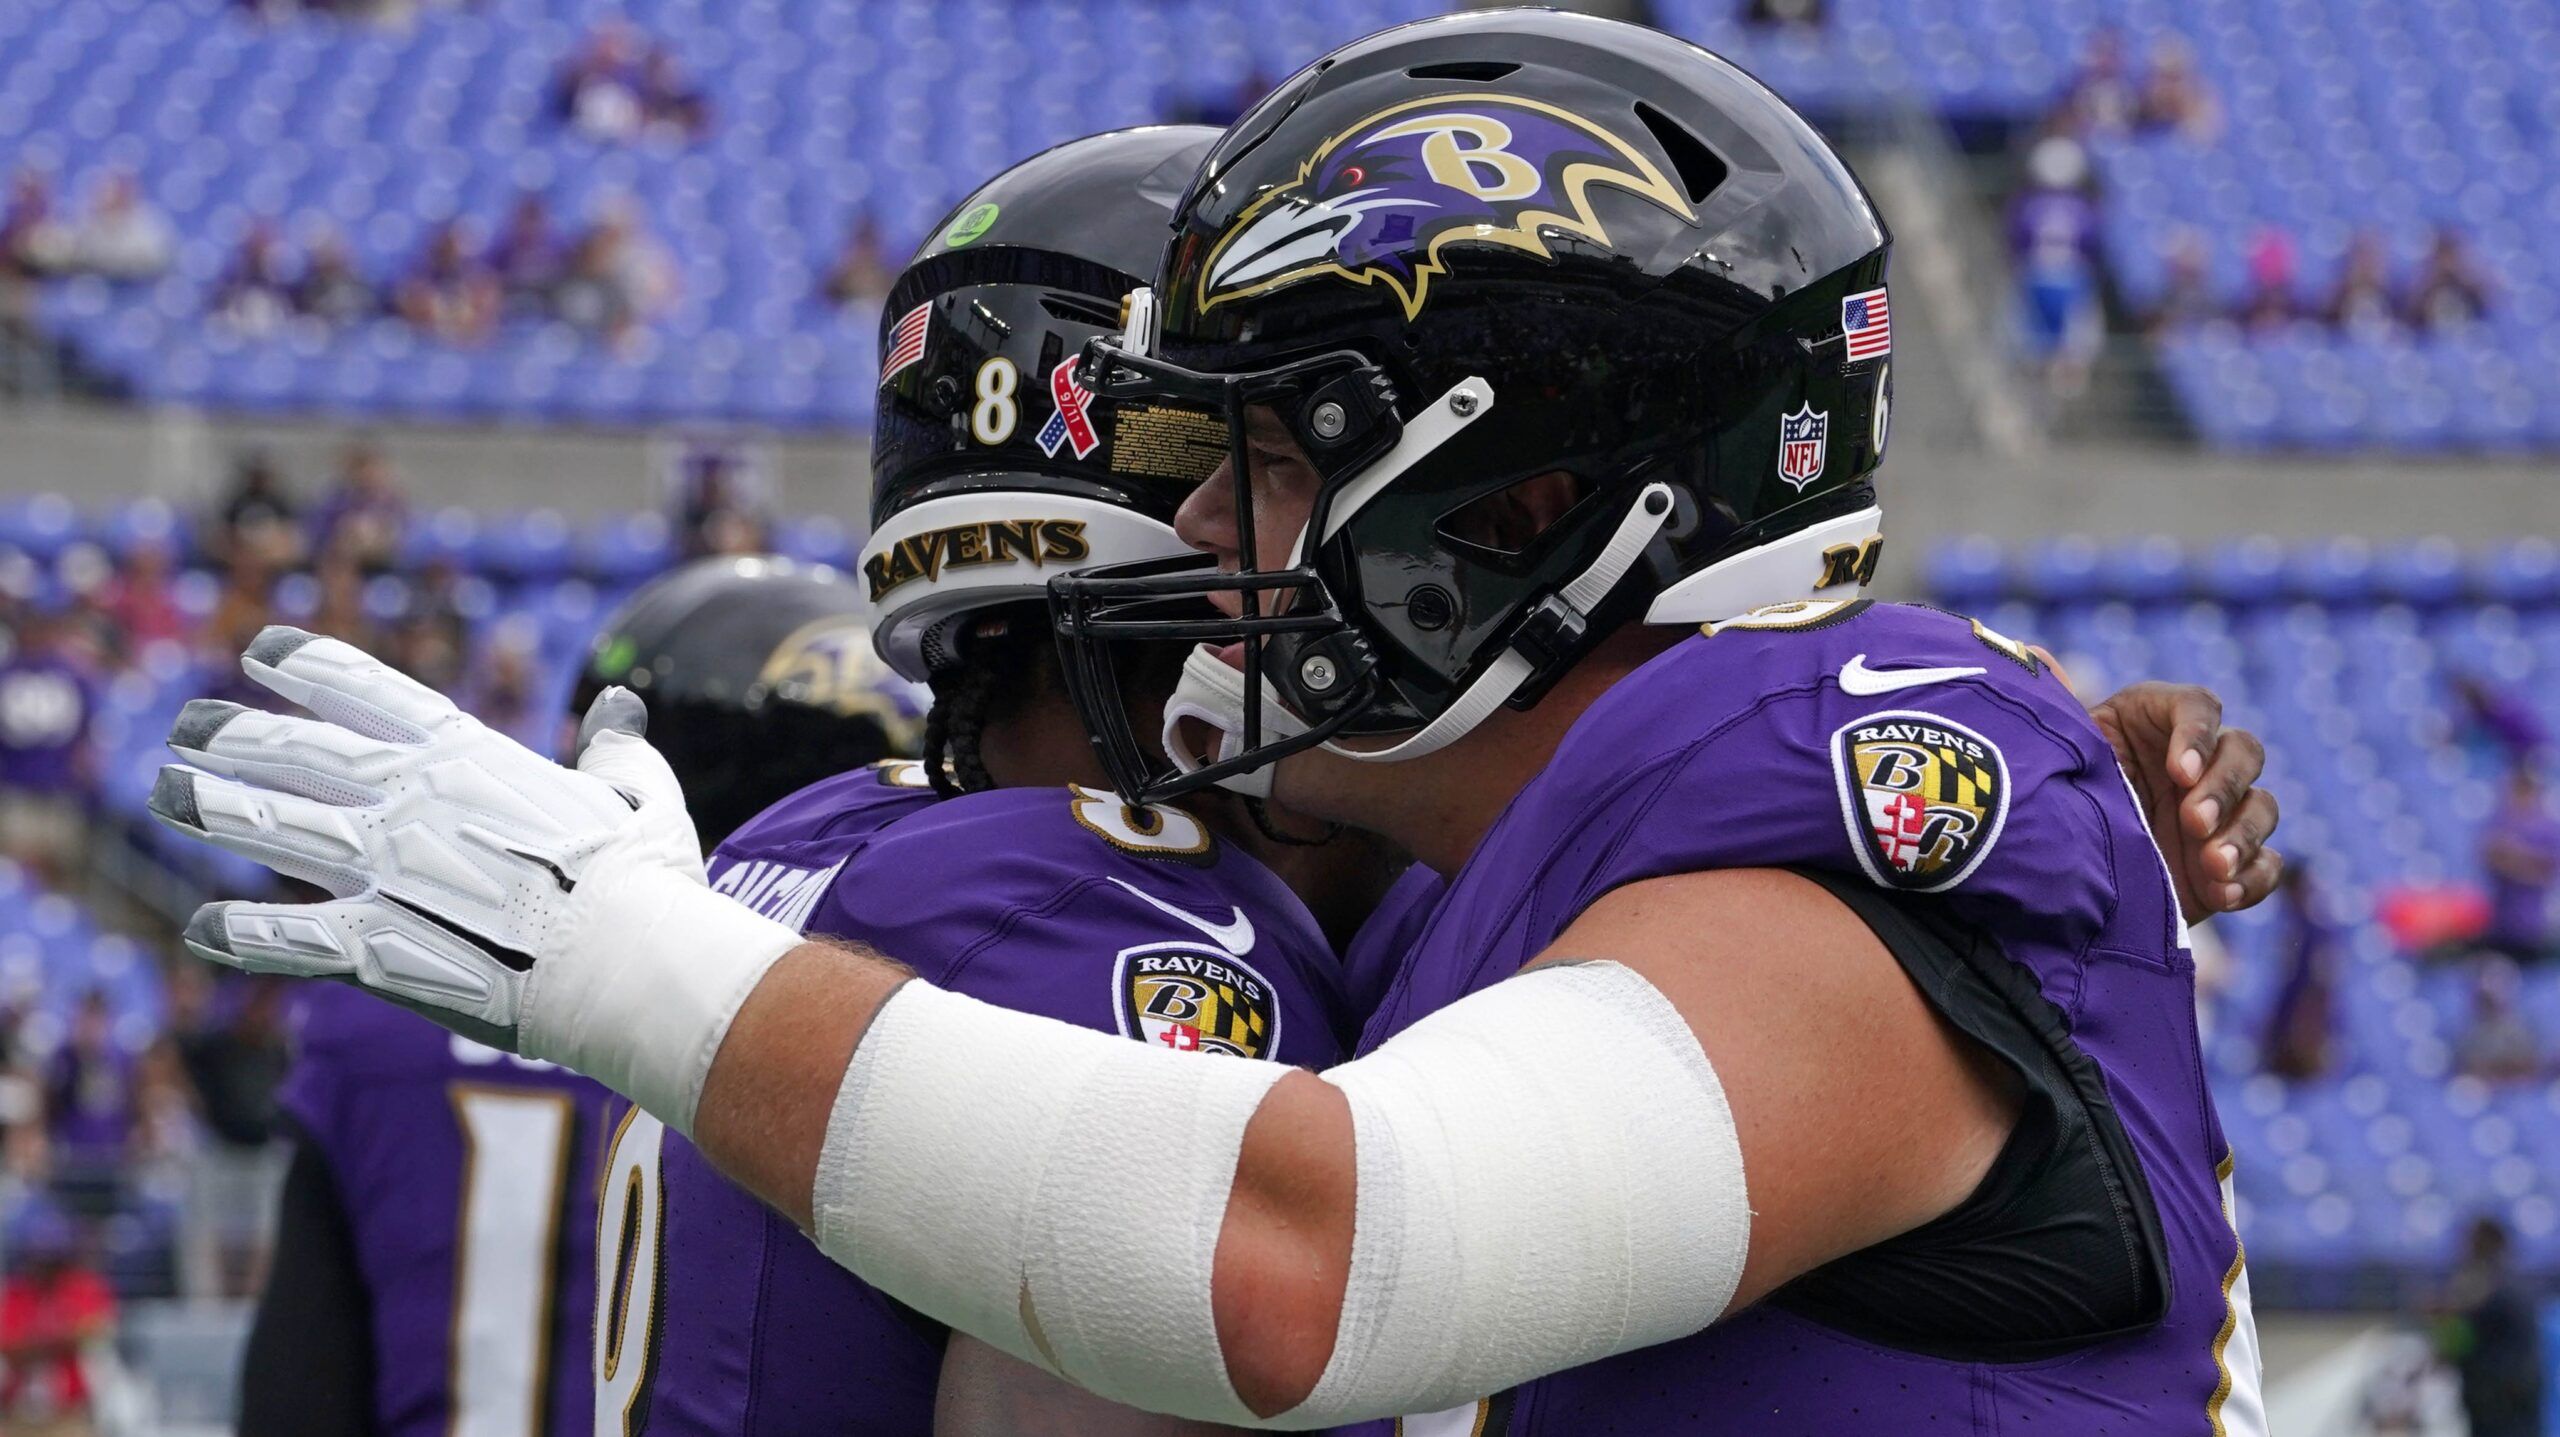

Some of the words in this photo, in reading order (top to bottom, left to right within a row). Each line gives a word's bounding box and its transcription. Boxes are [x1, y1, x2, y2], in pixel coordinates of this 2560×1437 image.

[1354, 113, 1542, 202] B
[971, 355, 1019, 446] 8
[1060, 391, 1081, 424] 9/11
[1147, 404, 1210, 421] WARNING
[1785, 441, 1820, 478] NFL
[863, 518, 1091, 603] RAVENS
[1853, 724, 1985, 760] RAVENS
[1856, 744, 1931, 792] B
[1917, 805, 1979, 862] R
[1135, 975, 1209, 1021] B
[1136, 955, 1261, 1001] RAVENS
